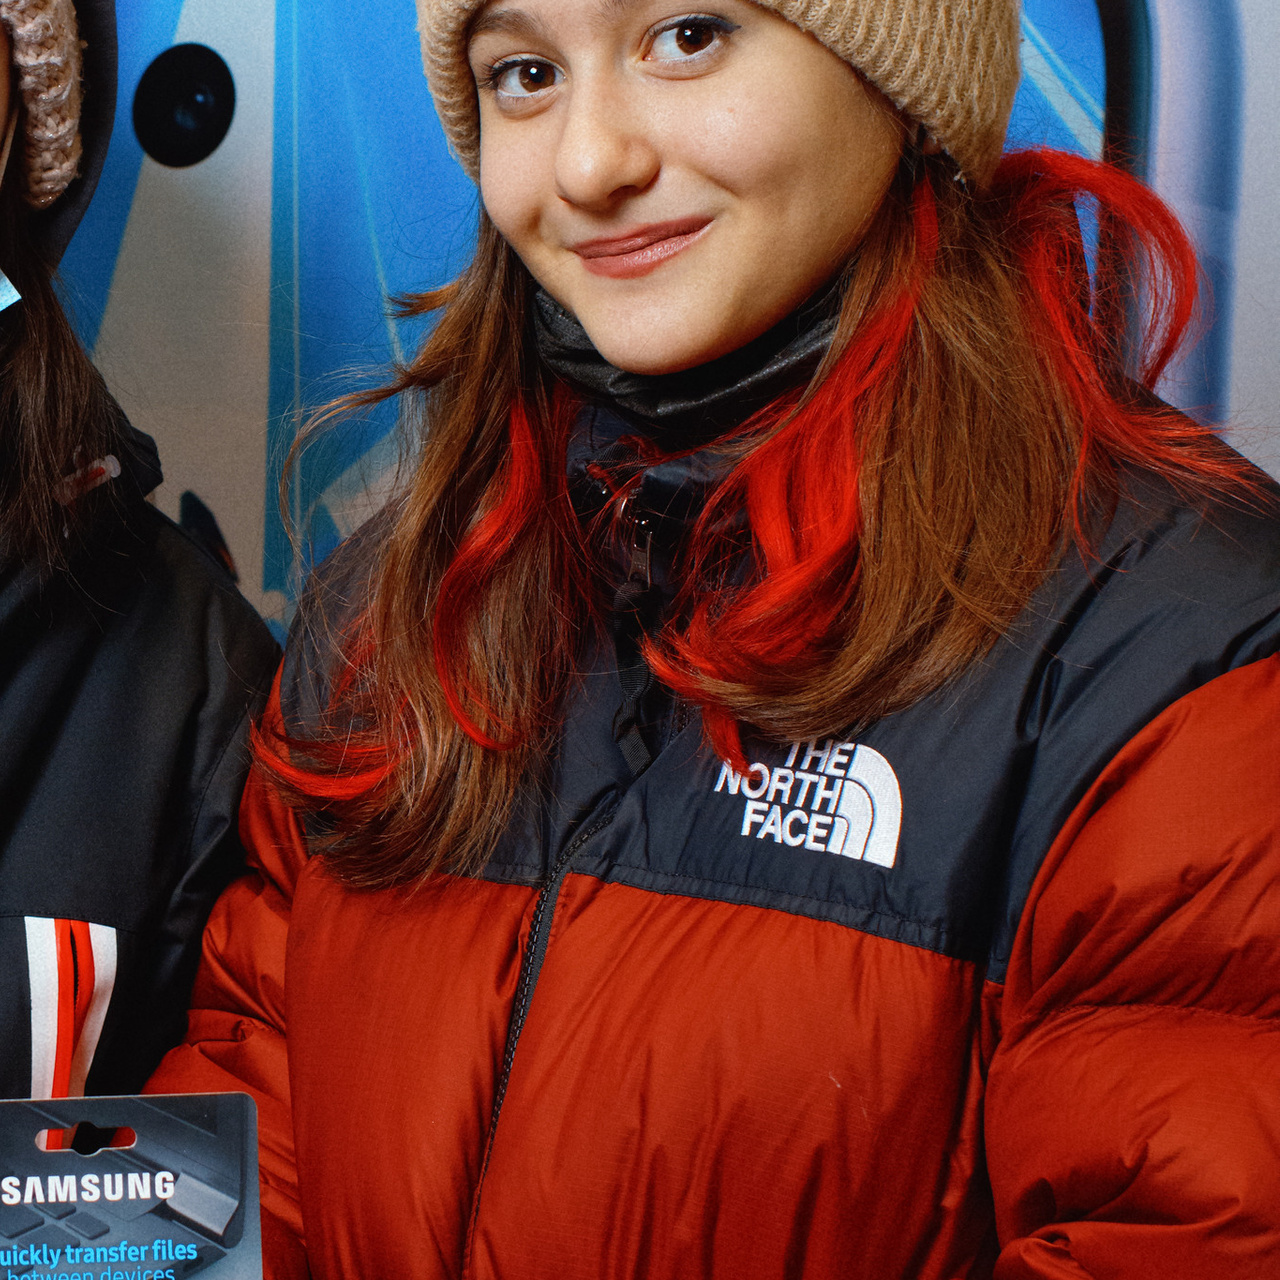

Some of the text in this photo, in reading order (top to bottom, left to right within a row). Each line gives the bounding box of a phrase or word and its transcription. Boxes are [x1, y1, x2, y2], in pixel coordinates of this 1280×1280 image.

[785, 739, 856, 778] THE
[714, 758, 843, 815] NORTH
[741, 799, 833, 852] FACE
[1, 1171, 176, 1206] SAMSUNG
[65, 1241, 149, 1265] transfer
[152, 1239, 198, 1261] files
